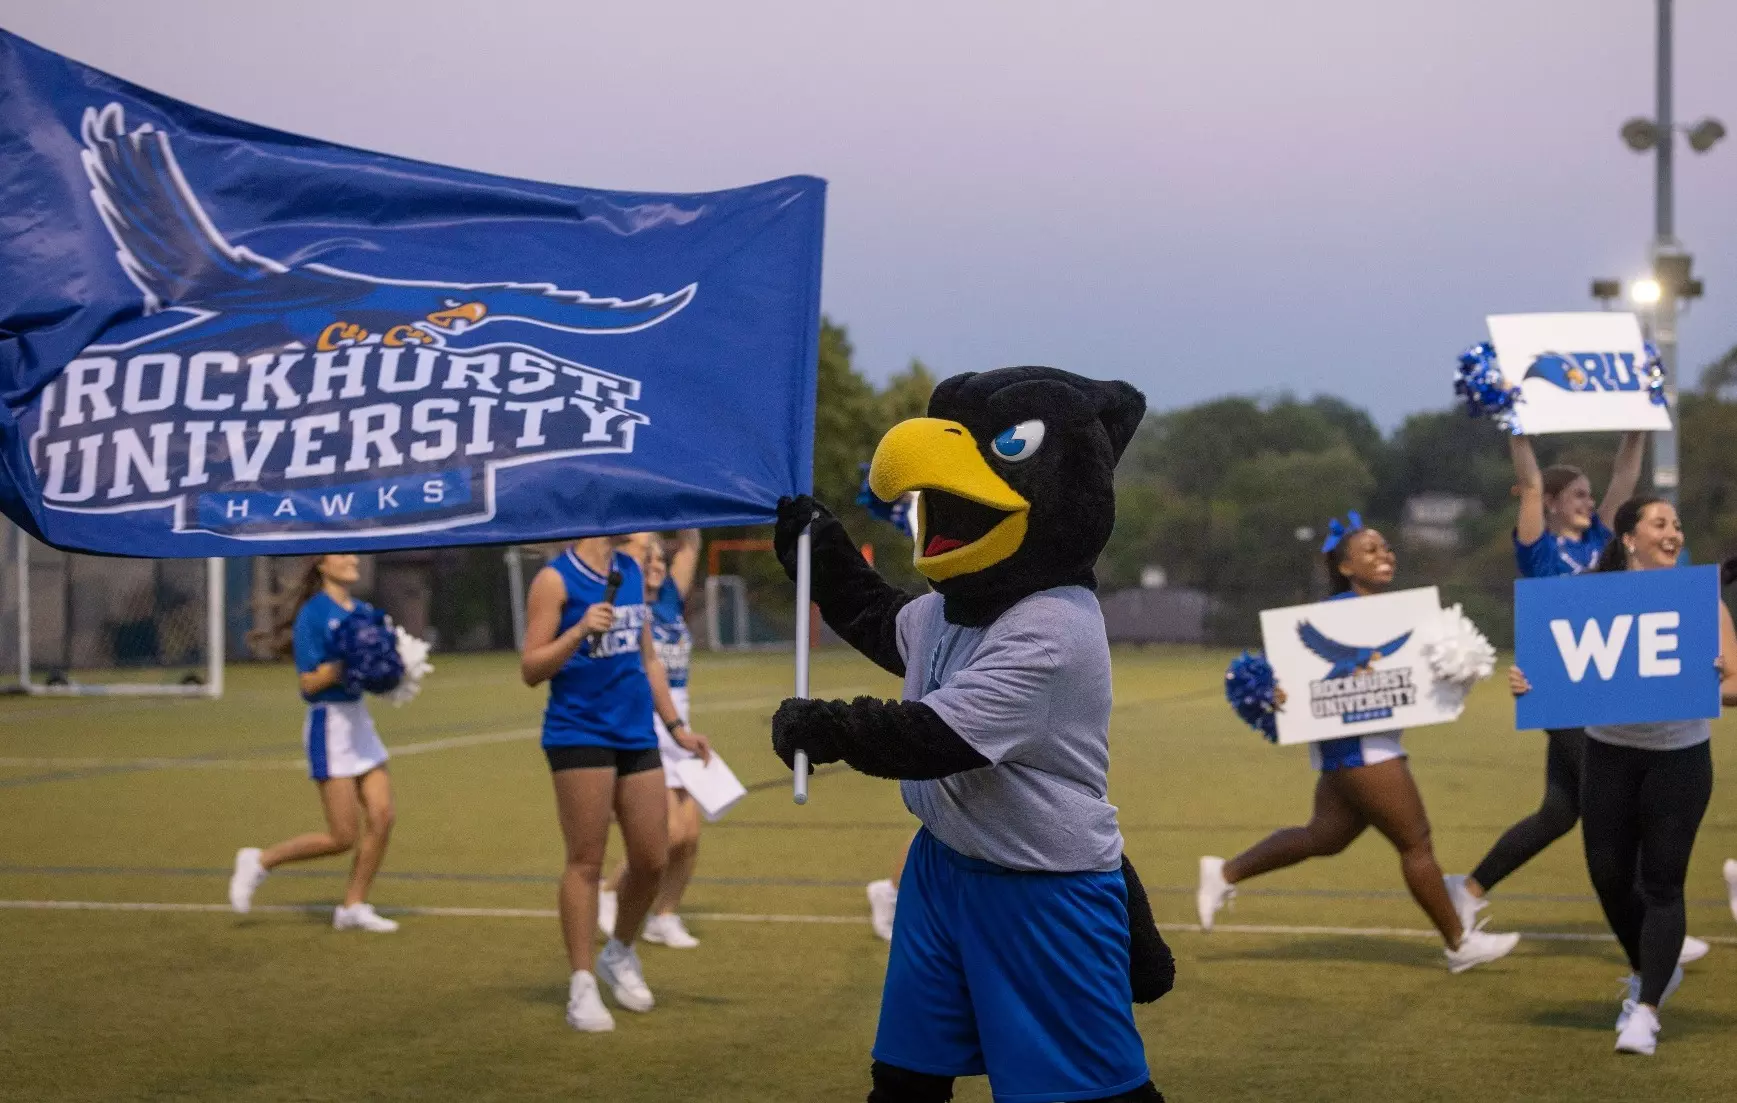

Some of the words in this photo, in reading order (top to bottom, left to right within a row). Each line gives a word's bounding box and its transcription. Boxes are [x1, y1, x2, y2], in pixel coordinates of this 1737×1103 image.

[58, 346, 619, 428] ROCKHURST
[1569, 352, 1641, 392] RU
[42, 396, 631, 502] UNIVERSITY
[226, 479, 444, 519] HAWKS
[1549, 611, 1681, 682] WE
